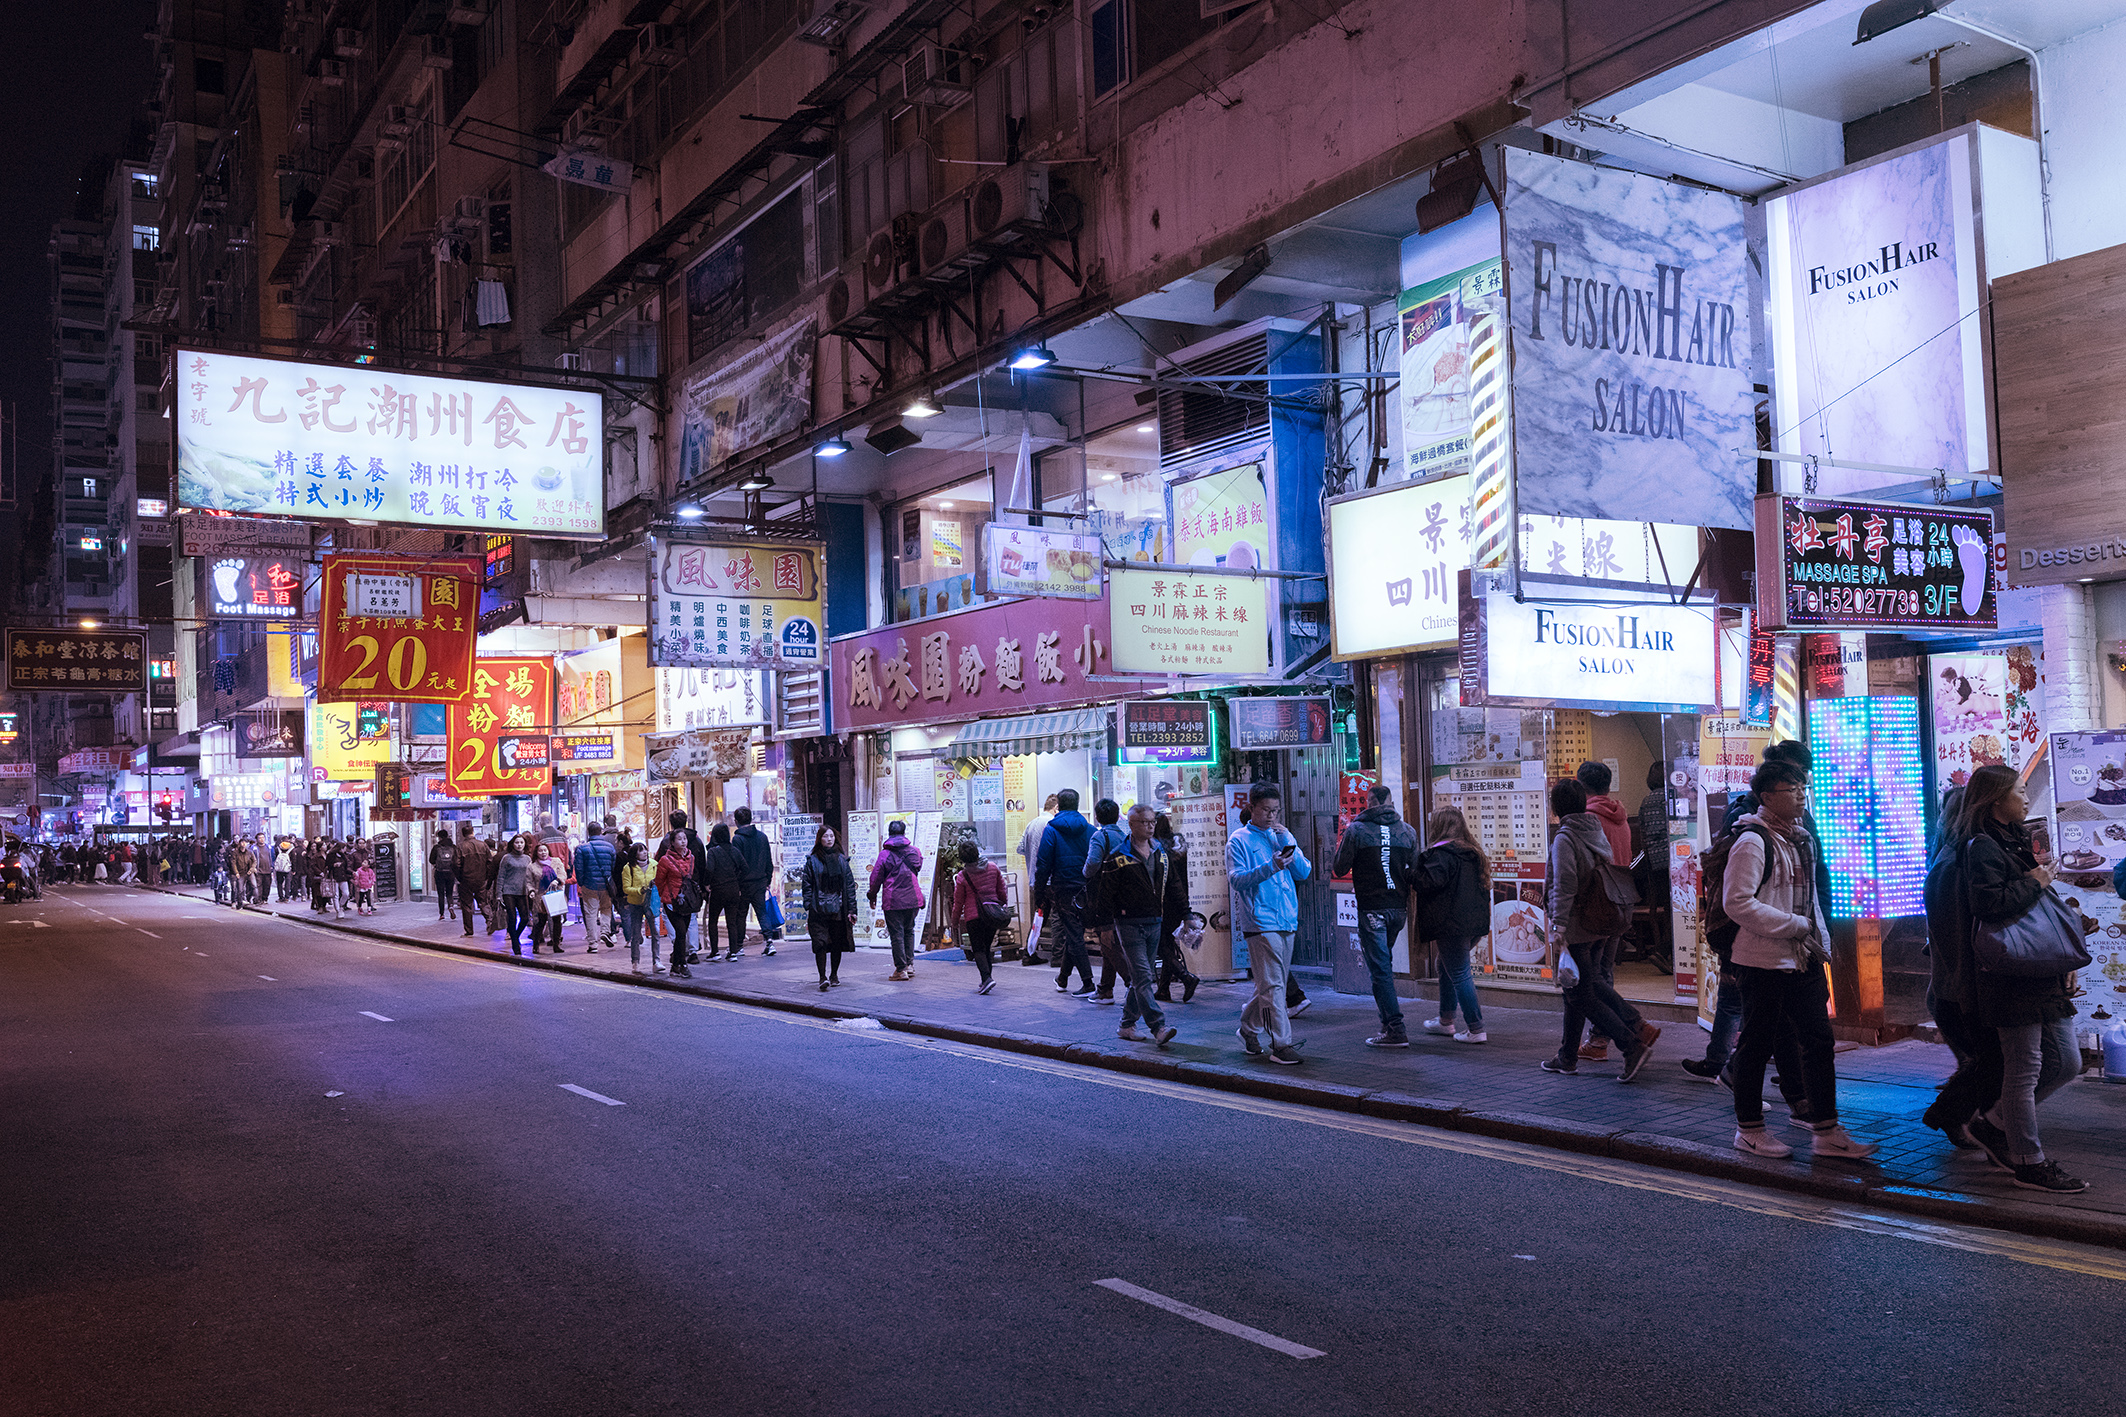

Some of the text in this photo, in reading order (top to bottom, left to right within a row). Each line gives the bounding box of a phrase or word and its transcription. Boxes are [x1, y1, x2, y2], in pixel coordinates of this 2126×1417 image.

[1848, 278, 1900, 305] SALON
[190, 356, 212, 427] 老字號
[227, 375, 589, 455] 九記潮州食店
[1592, 377, 1688, 441] SALON
[274, 449, 390, 483] 精選套餐
[409, 461, 519, 492] 潮州打冷
[274, 480, 385, 512] 特式小炒
[409, 490, 519, 521] 晚飯宵夜
[532, 516, 597, 529] 2393 1598
[1891, 517, 1924, 546] 足浴
[1928, 522, 1949, 546] 24
[184, 532, 212, 541] FOOT
[1009, 530, 1083, 550] 風味園
[1790, 512, 1890, 564] 牡丹亭
[1893, 547, 1926, 577] 美容
[1927, 545, 1953, 568] 小時
[676, 547, 805, 597] 風味園
[1793, 562, 1888, 584] MASSAGE SPA
[1038, 582, 1061, 592] 2142
[1064, 584, 1087, 593] 3988
[1151, 580, 1228, 601] 景霖正宗
[1924, 584, 1958, 616] 3/F
[216, 603, 296, 616] Foot Massage
[1130, 603, 1249, 623] 四川麻辣米線
[670, 601, 682, 654] 精美小菜
[716, 603, 728, 655] 中西美食
[739, 604, 751, 656] 咖啡奶茶
[789, 622, 809, 636] 24
[789, 635, 809, 644] hour
[1142, 624, 1239, 637] Chinese Noodle Restaurant
[339, 635, 428, 691] 20
[1578, 656, 1635, 675] SALON
[466, 703, 536, 733] 粉麵
[519, 742, 547, 750] Welcome
[1131, 732, 1204, 743] TEL:2393 2852
[1279, 730, 1299, 742] 0699
